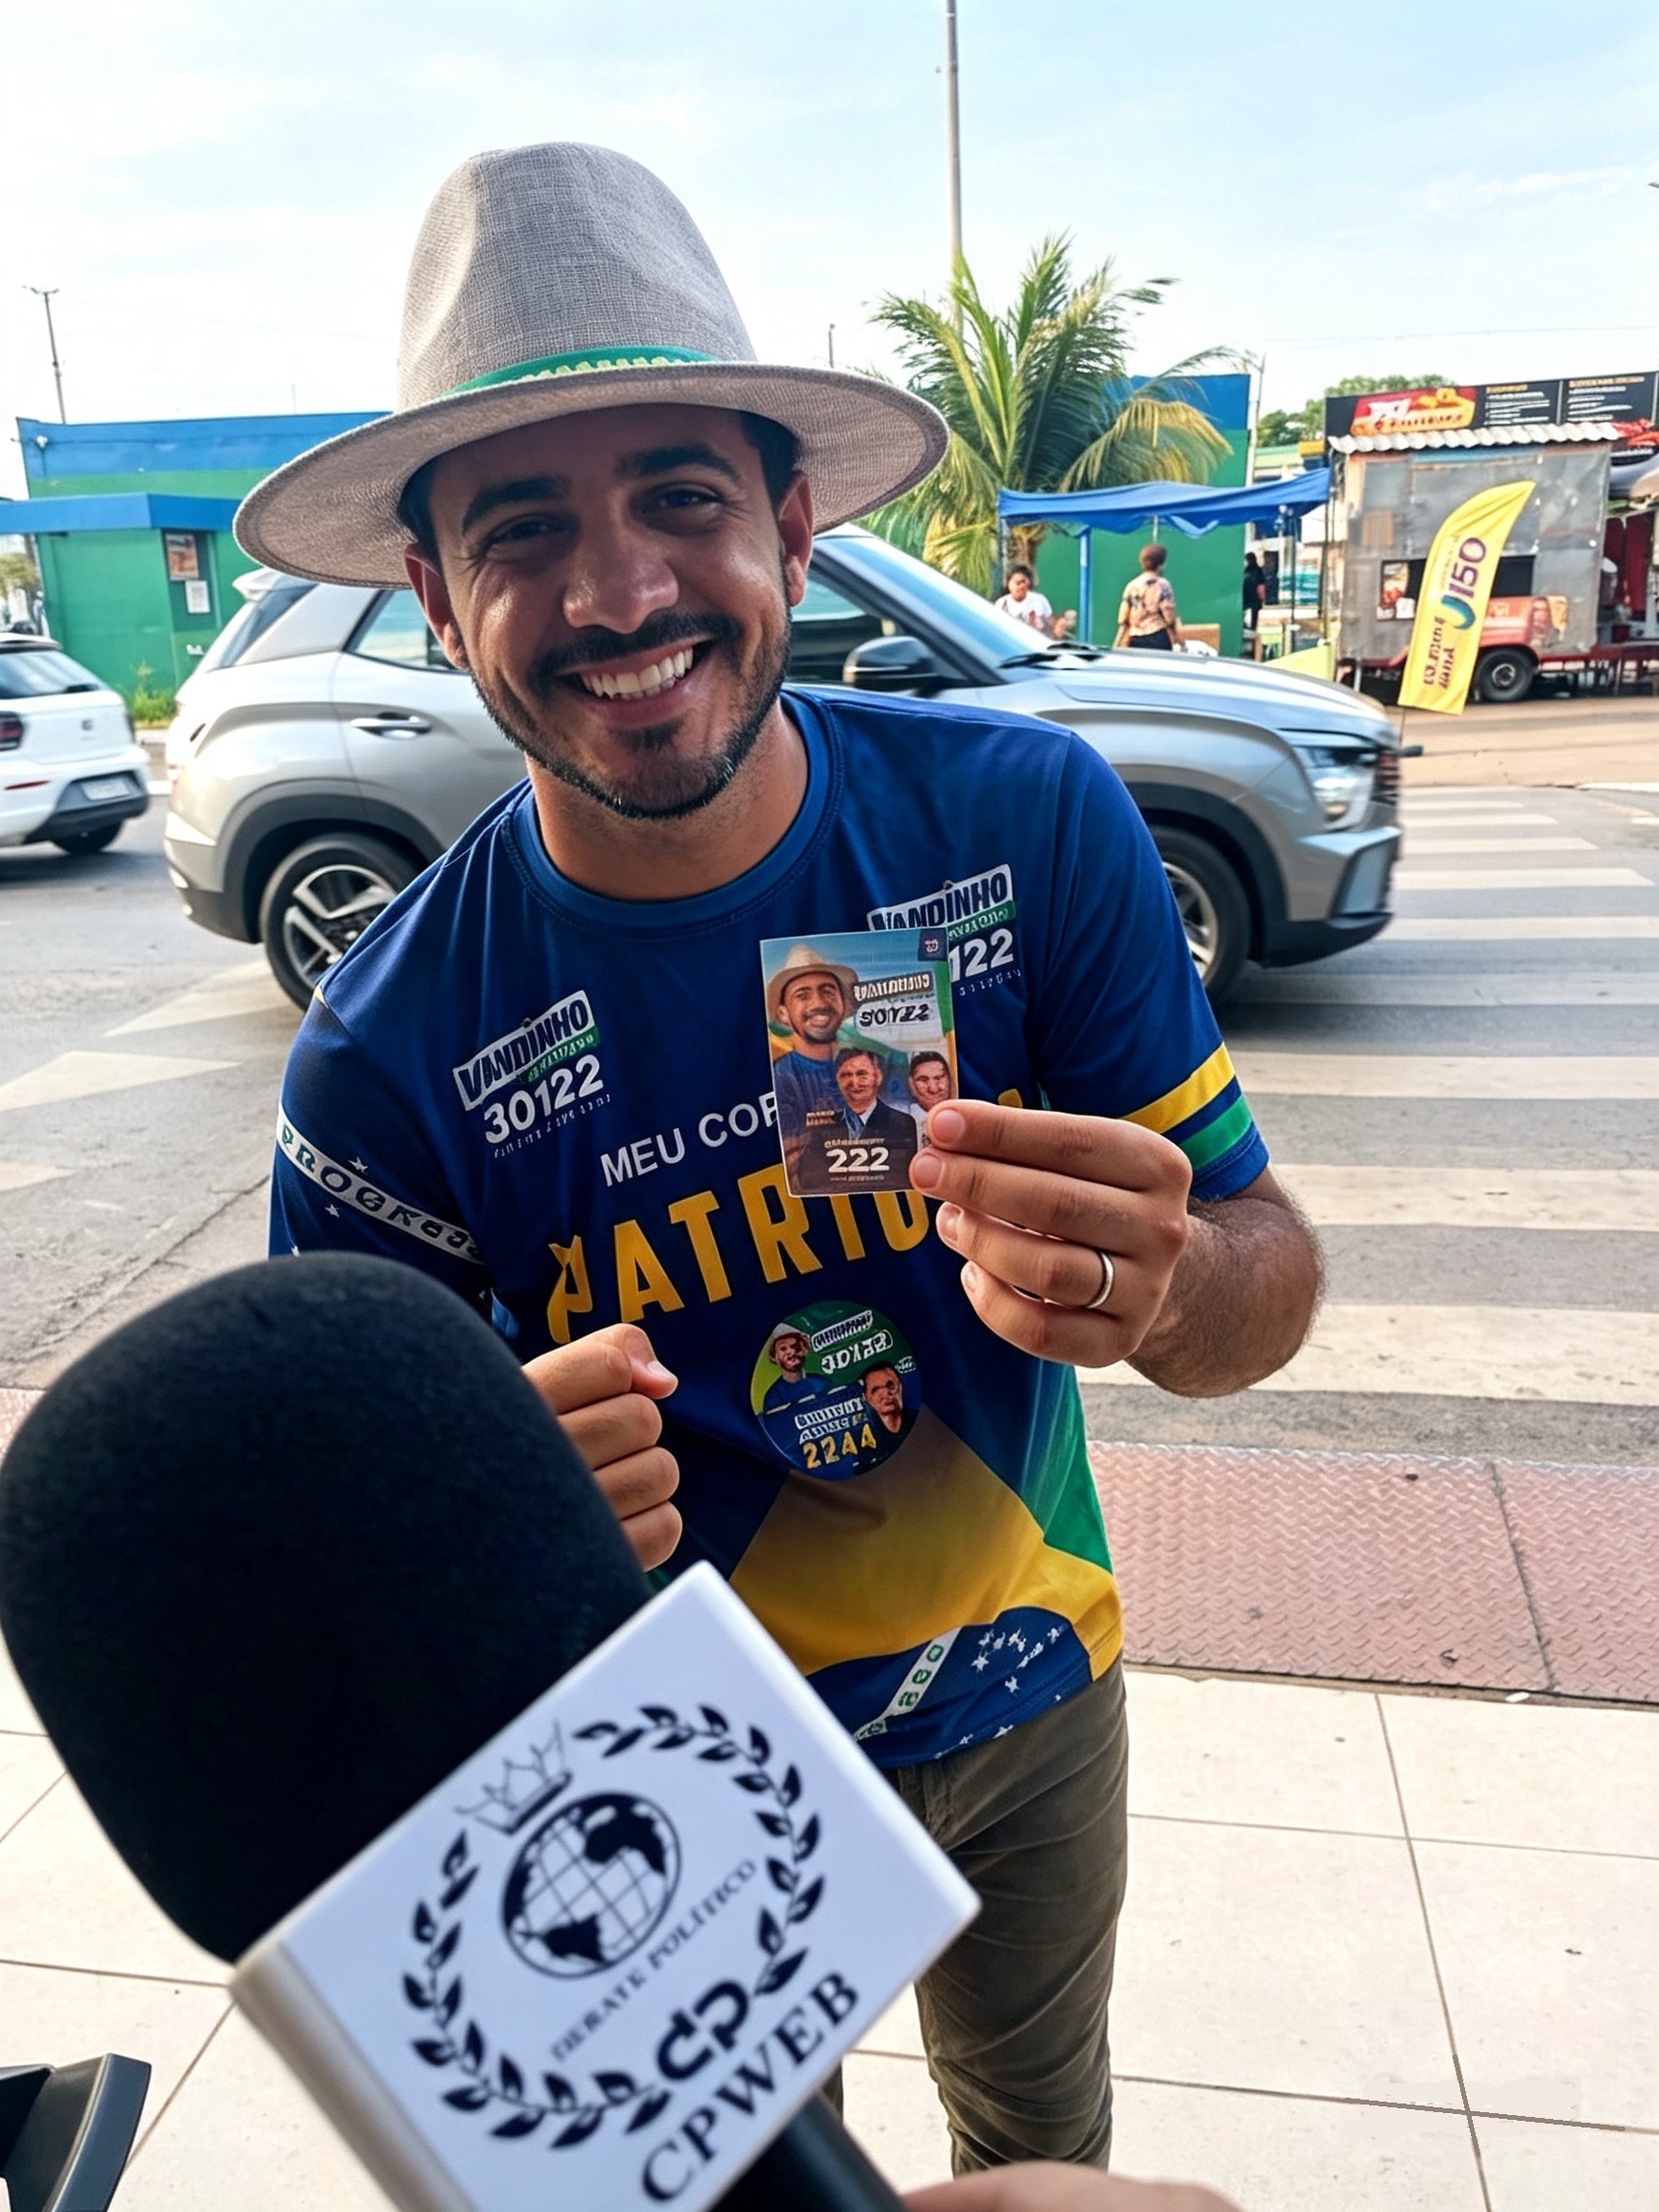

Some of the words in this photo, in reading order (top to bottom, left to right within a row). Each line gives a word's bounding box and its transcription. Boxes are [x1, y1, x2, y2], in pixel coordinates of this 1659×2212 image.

[948, 927, 1014, 983] 122
[458, 998, 589, 1105] VANDINHO
[483, 1054, 605, 1144] 30122
[600, 1127, 685, 1188] MEU
[826, 1146, 890, 1173] 222
[546, 1088, 1023, 1345] PATRIO
[640, 1970, 860, 2204] CPWEB
